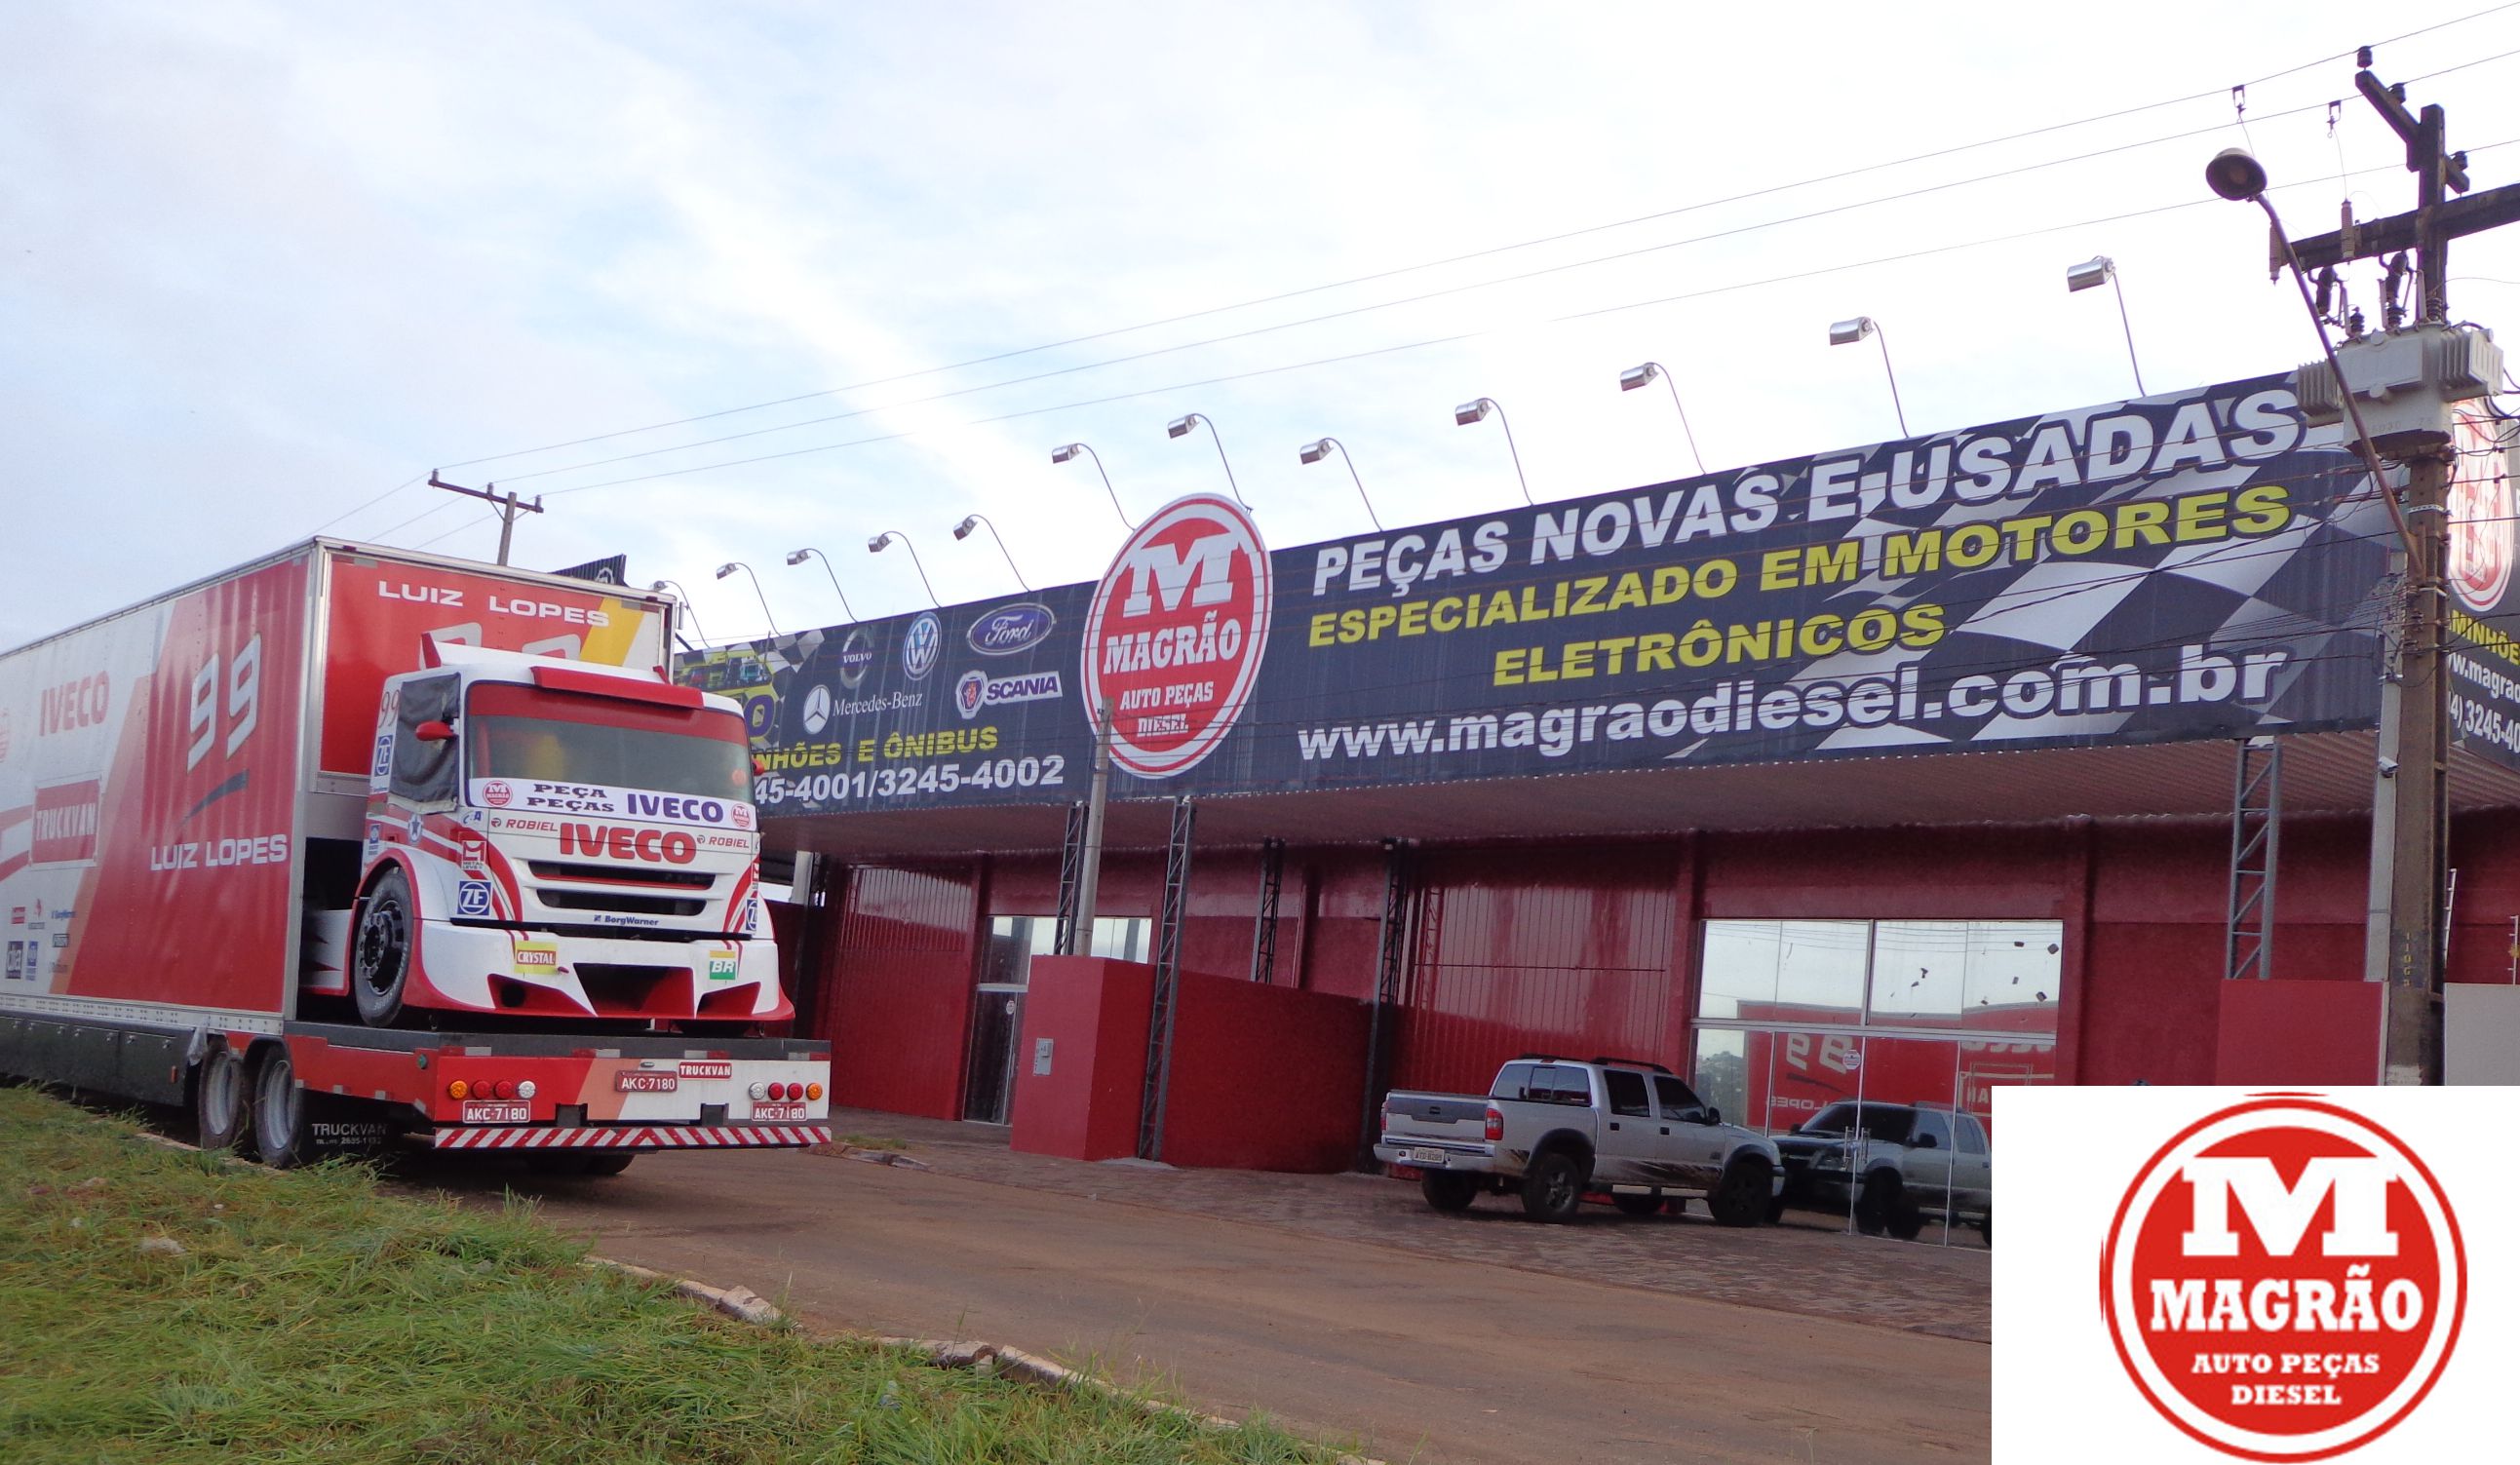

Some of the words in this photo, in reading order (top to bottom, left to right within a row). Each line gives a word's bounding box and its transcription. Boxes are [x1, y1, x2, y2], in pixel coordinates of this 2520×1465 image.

[1313, 520, 1509, 597] PEÇAS
[1530, 477, 1779, 564] NOVAS
[1807, 459, 1860, 521] E
[1891, 390, 2299, 509] USADAS
[1123, 531, 1240, 618] M
[1309, 559, 1737, 646] ESPECIALIZADO
[1761, 540, 1860, 592] EM
[1883, 485, 2291, 577] MOTORES
[378, 581, 463, 607] LUIZ
[488, 596, 610, 628] LOPES
[985, 616, 1034, 644] Ford
[1103, 610, 1241, 675] MAGRÃO
[1493, 603, 1946, 685] ELETRÔNICOS
[2449, 609, 2520, 666] MINHÕE
[843, 652, 872, 664] VOLVO
[187, 632, 261, 773] 99
[986, 675, 1059, 701] SCANIA
[1120, 687, 1160, 710] AUTO
[1165, 681, 1214, 709] PEÇAS
[1298, 644, 2289, 760] www.magraodiesel.com.br
[39, 671, 110, 737] IVECO
[378, 689, 401, 729] 99
[833, 692, 923, 717] Mercedes-Benz
[1138, 713, 1188, 738] DIESEL
[378, 745, 390, 768] ZF
[752, 743, 841, 772] NHÕES
[858, 739, 876, 761] E
[884, 726, 999, 758] ÔNIBUS
[533, 784, 607, 798] PEÇA
[755, 755, 1065, 806] 45-4001/3245-4002
[35, 802, 96, 841] TRUCKVAN
[526, 797, 614, 812] PEÇAS
[627, 793, 723, 823] IVECO
[506, 819, 559, 832] ROBIEL
[150, 841, 198, 871] LUIZ
[206, 833, 287, 867] LOPES
[560, 822, 697, 865] IVECO
[709, 836, 750, 849] ROBIEL
[462, 888, 487, 908] ZF
[604, 914, 659, 926] BorgWarner
[517, 951, 555, 965] CRYSTAL
[712, 959, 734, 974] BR
[679, 1064, 731, 1076] TRUCKVAN
[312, 1123, 389, 1136] TRUCKVAN
